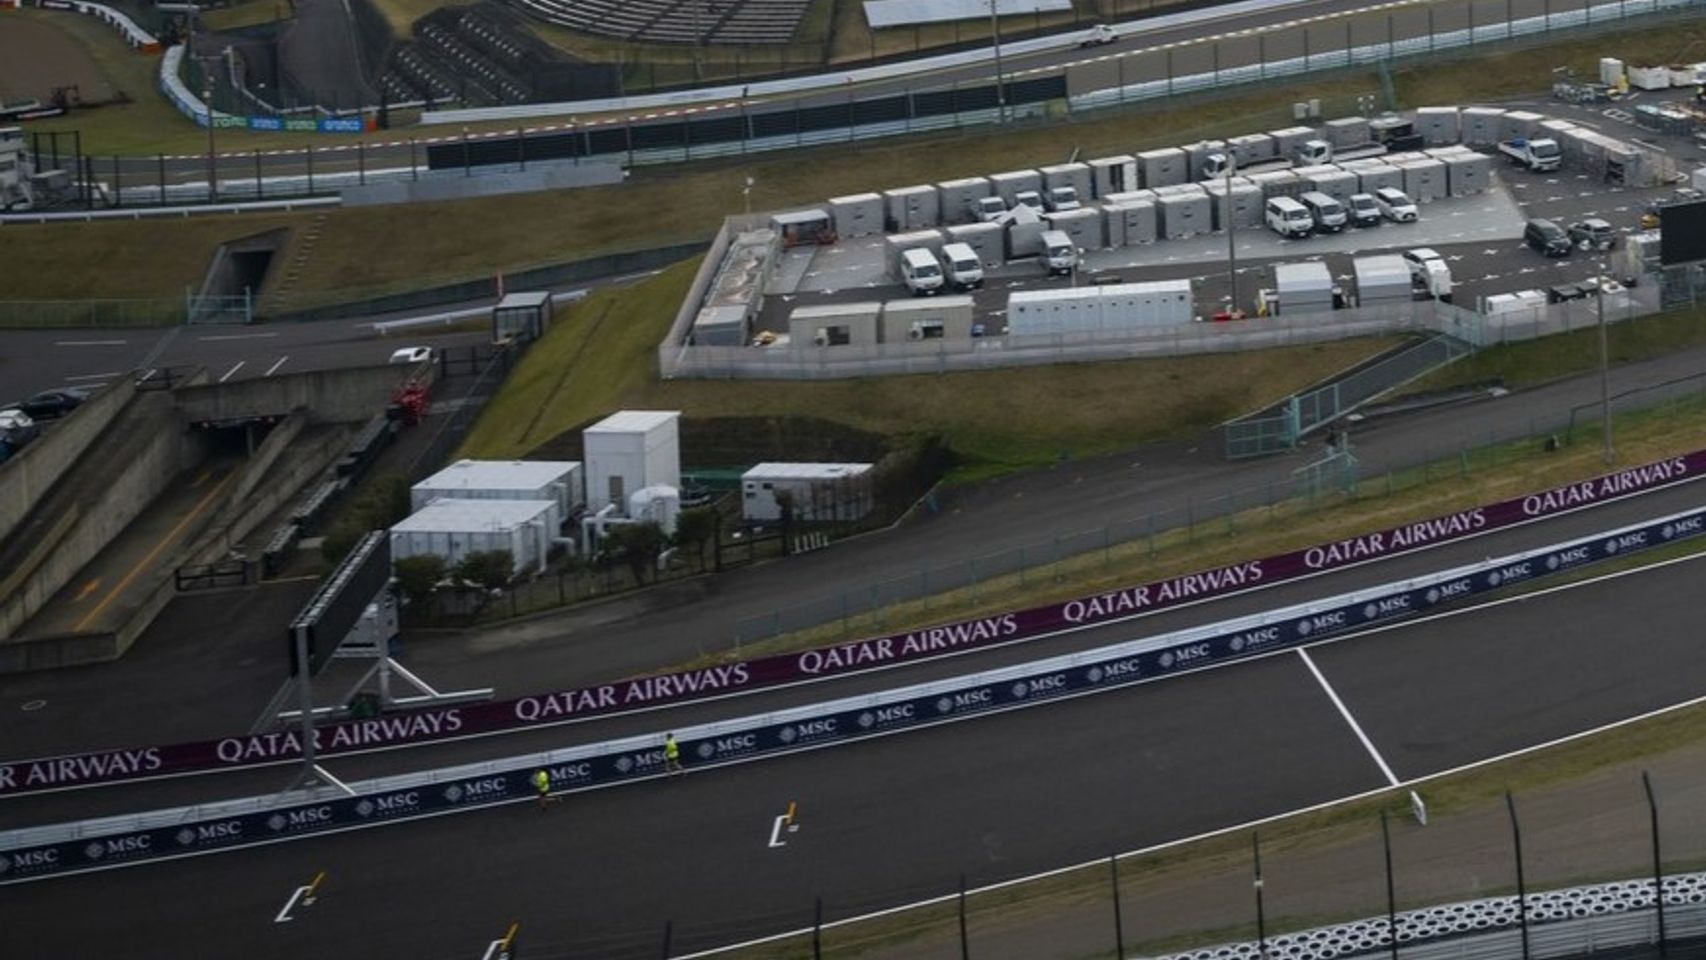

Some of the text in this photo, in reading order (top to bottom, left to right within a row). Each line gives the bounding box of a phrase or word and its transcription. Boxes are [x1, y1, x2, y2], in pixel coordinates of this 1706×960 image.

[1522, 457, 1687, 516] QATAR AIRWAYS
[1674, 517, 1702, 534] MSC
[1304, 507, 1486, 568] QATAR AIRWAYS
[1618, 531, 1647, 549] MSC
[1560, 546, 1590, 564] MSC
[1501, 562, 1532, 581] MSC
[1063, 560, 1263, 623] QATAR AIRWAYS
[1440, 579, 1472, 598] MSC
[1378, 595, 1410, 614] MSC
[1312, 611, 1346, 630] MSC
[799, 613, 1017, 674] QATAR AIRWAYS
[1246, 627, 1280, 646] MSC
[1176, 643, 1210, 661] MSC
[1104, 659, 1140, 677] MSC
[515, 662, 749, 721] QATAR AIRWAYS
[1030, 674, 1067, 692] MSC
[955, 689, 992, 707] MSC
[877, 703, 915, 721] MSC
[216, 710, 462, 762] QATAR AIRWAYS
[798, 718, 837, 736] MSC
[717, 734, 756, 752] MSC
[25, 747, 162, 785] AIRWAYS
[551, 762, 592, 781] MSC
[465, 776, 507, 796] MSC
[376, 791, 420, 811] MSC
[289, 805, 332, 825] MSC
[199, 820, 243, 840] MSC
[108, 835, 151, 854] MSC
[13, 849, 59, 869] MSC
